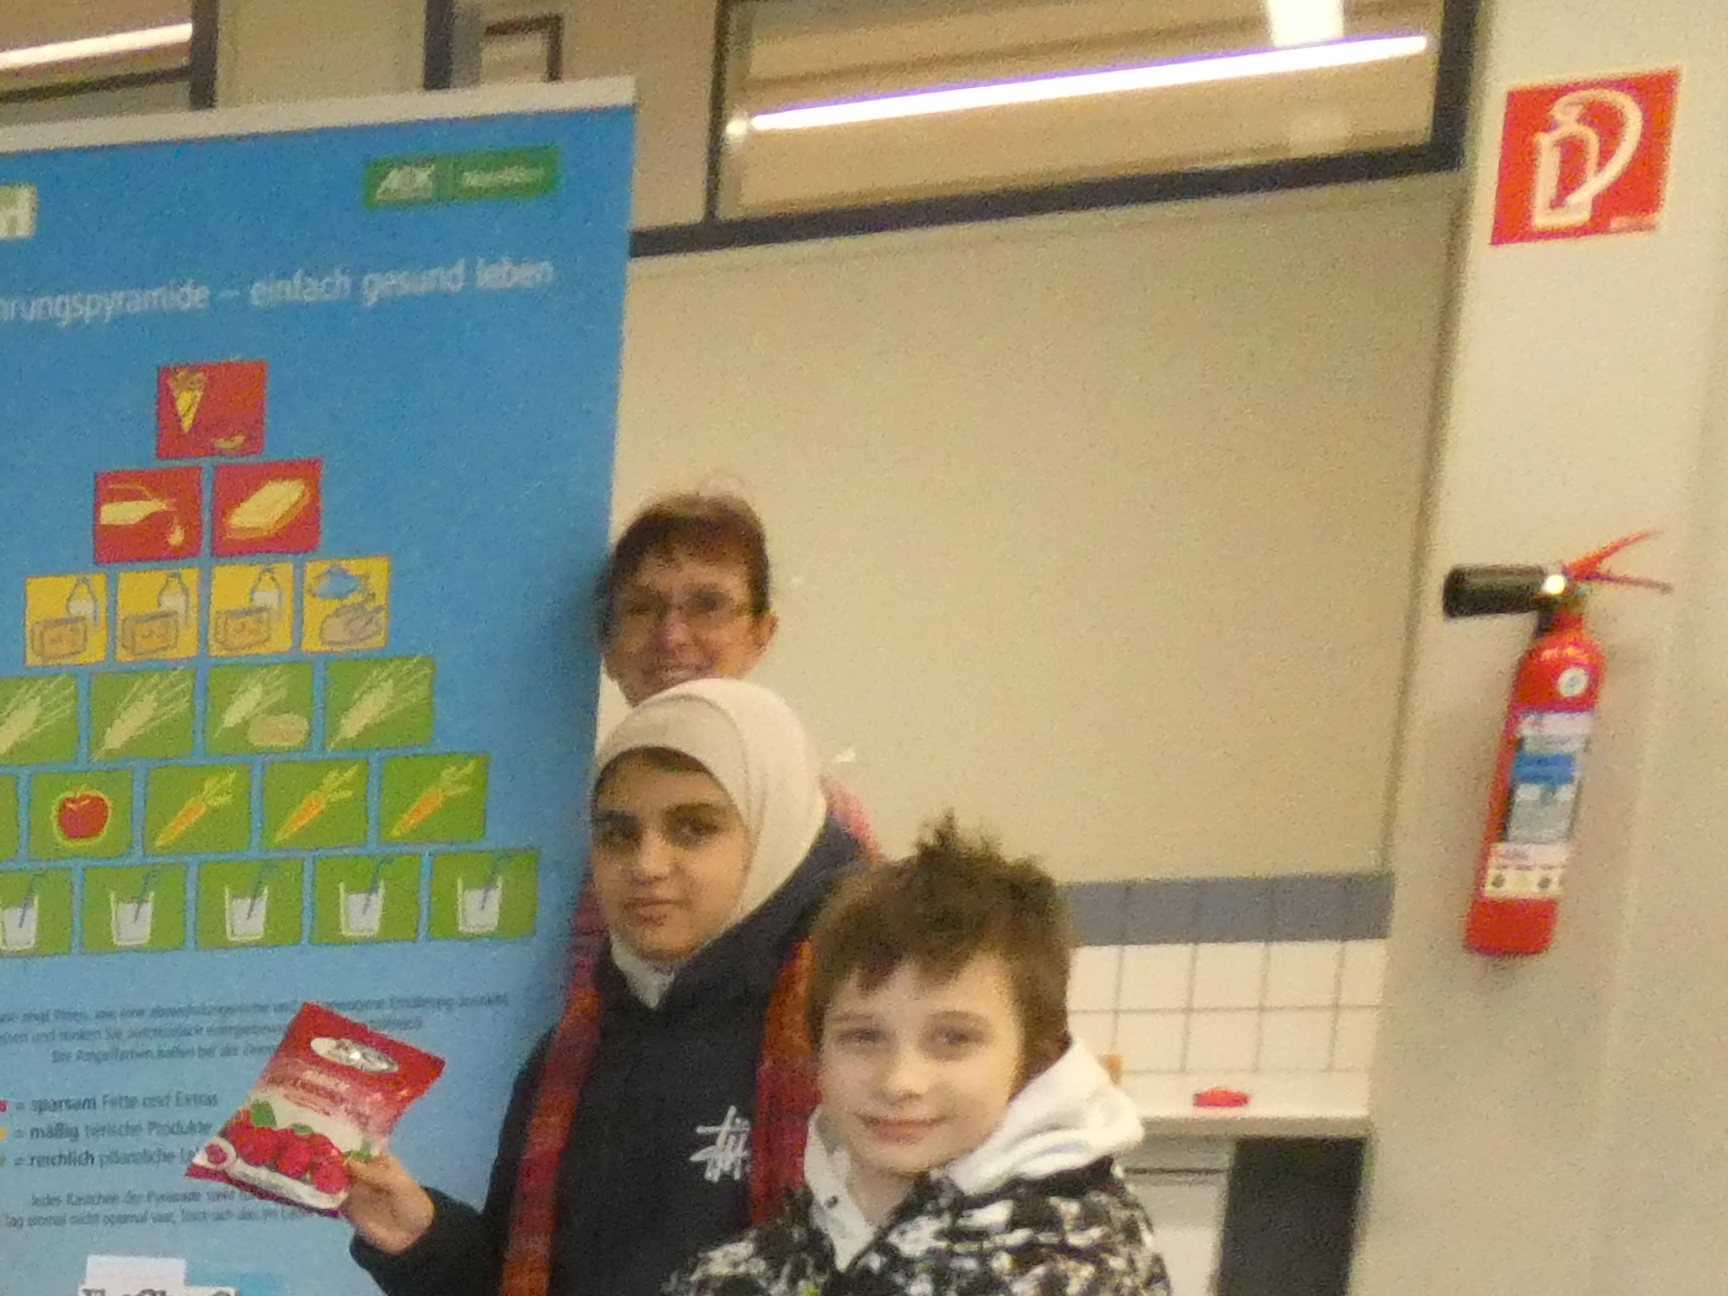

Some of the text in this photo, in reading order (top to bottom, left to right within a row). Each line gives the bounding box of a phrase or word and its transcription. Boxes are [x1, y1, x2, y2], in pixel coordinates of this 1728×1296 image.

[250, 266, 351, 307] einfach
[362, 258, 466, 307] gesund
[476, 257, 554, 290] leben
